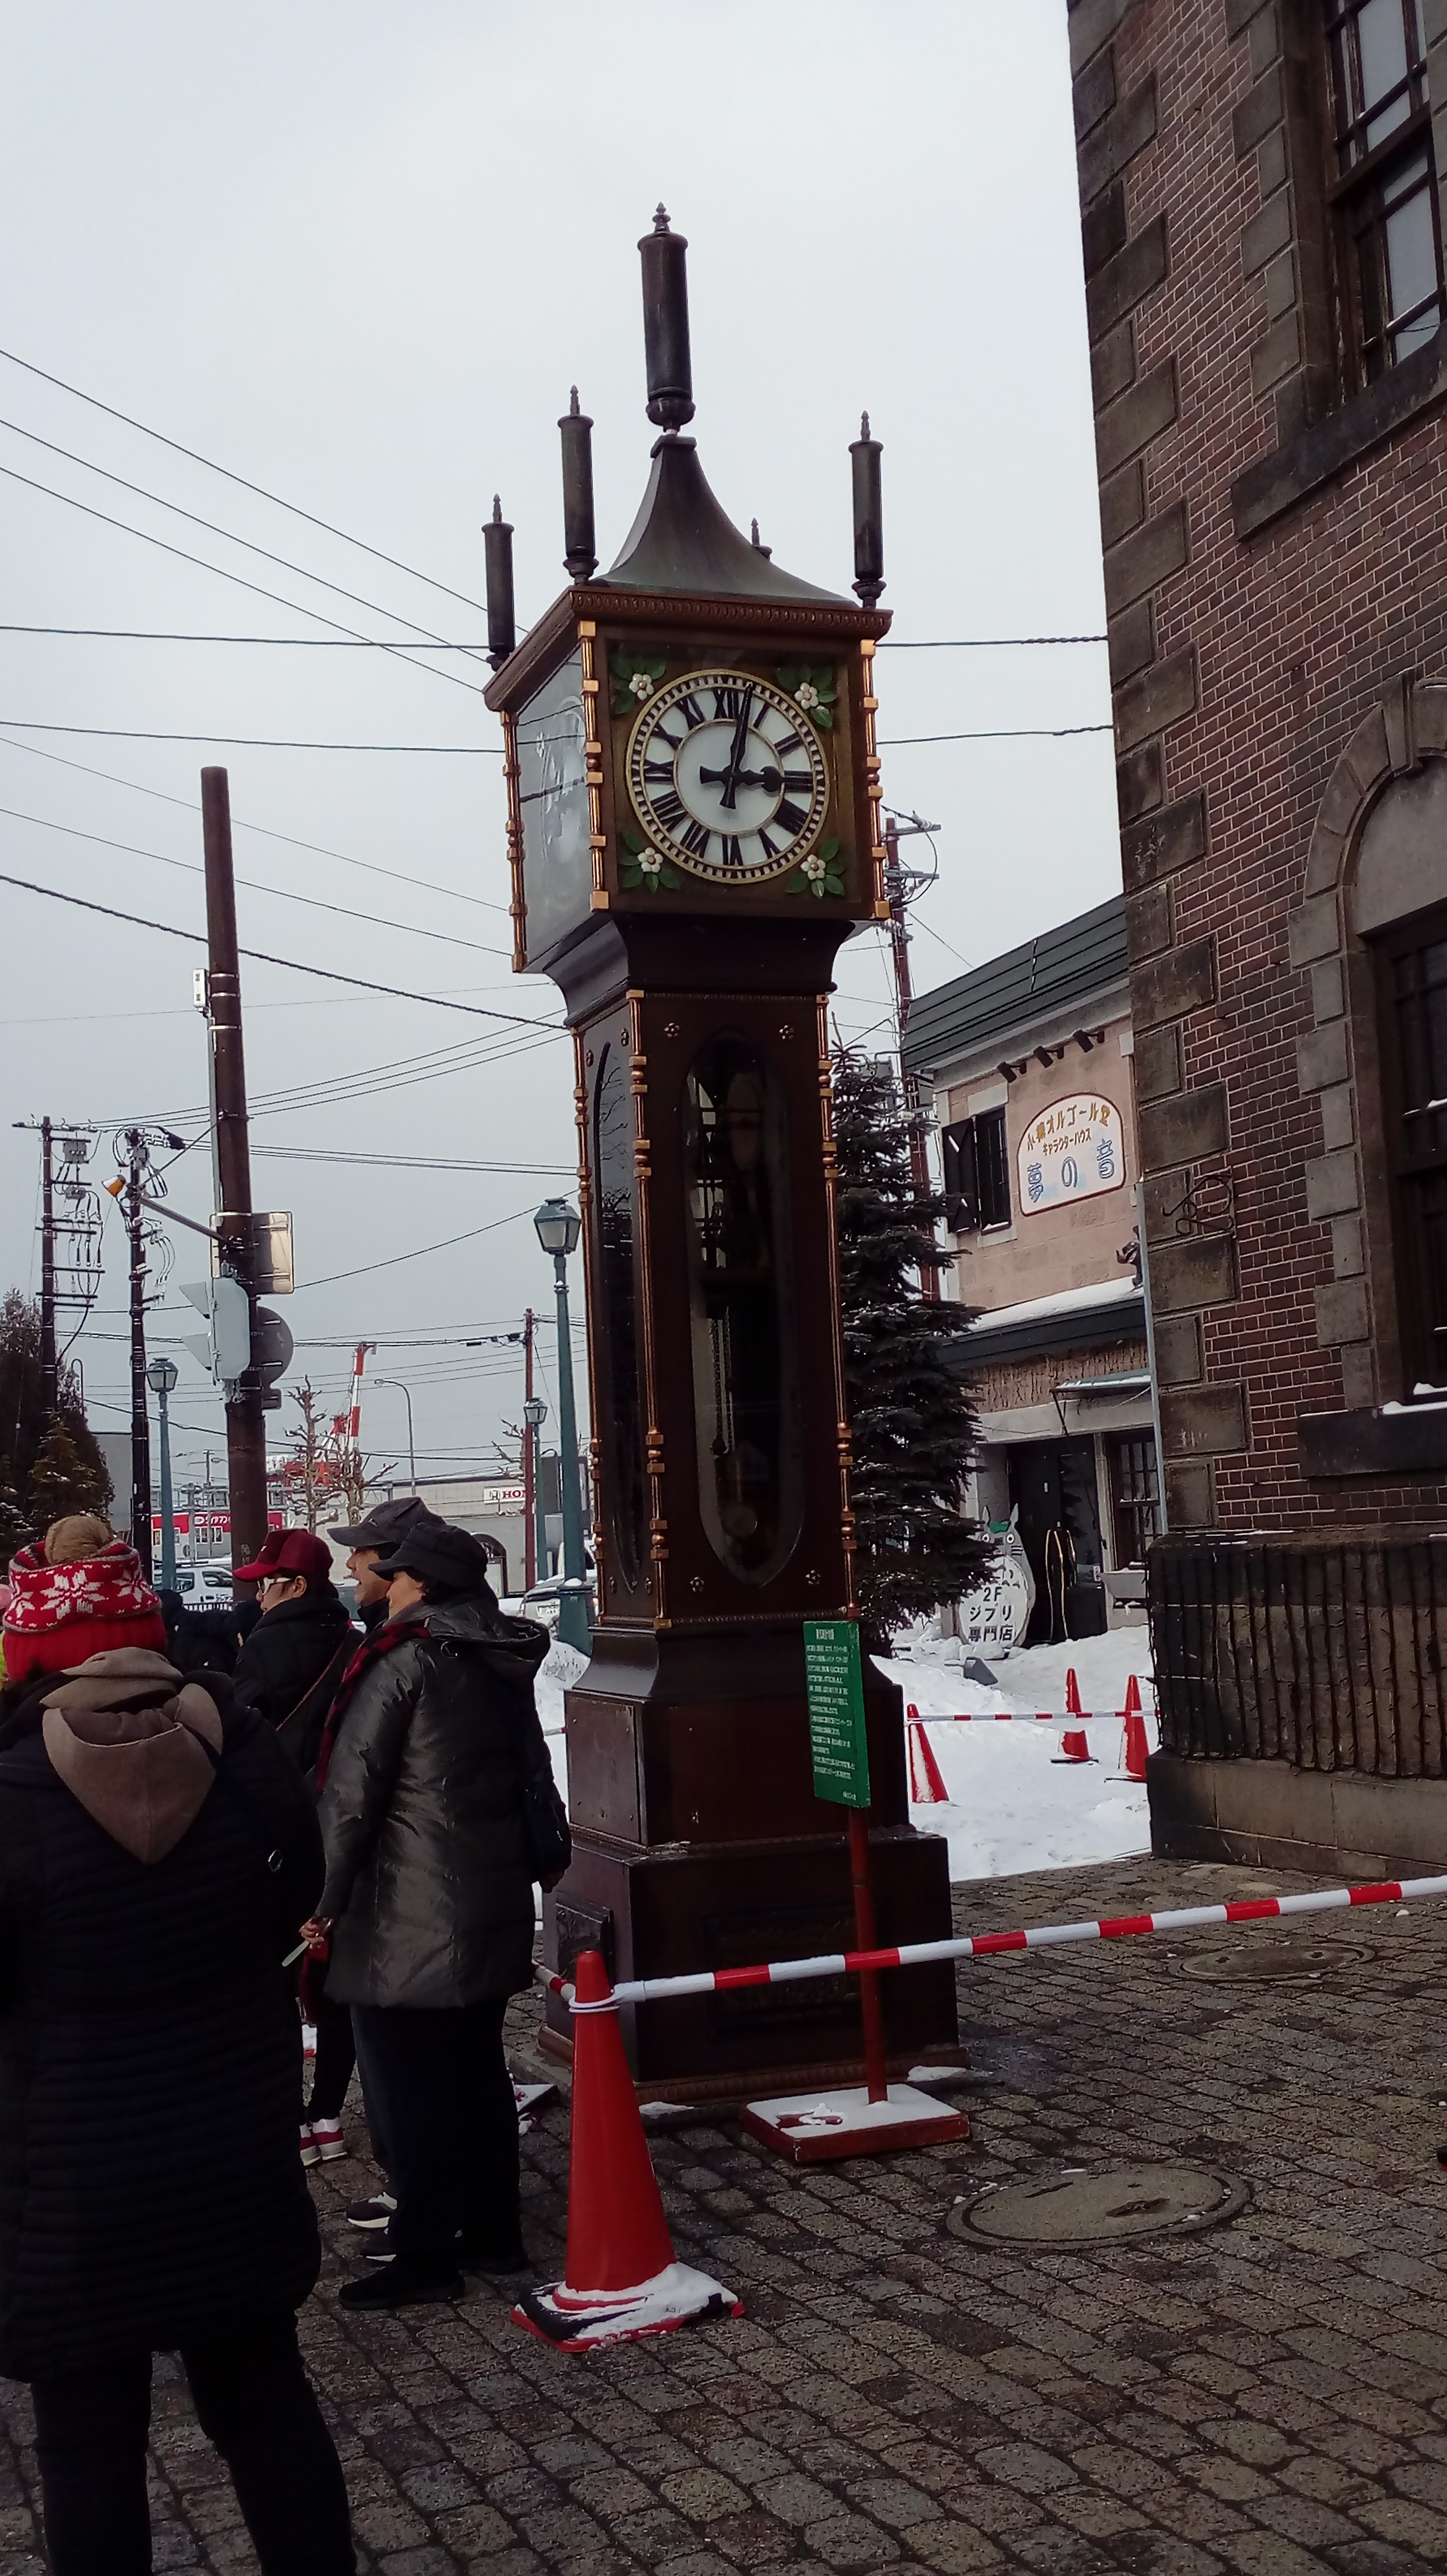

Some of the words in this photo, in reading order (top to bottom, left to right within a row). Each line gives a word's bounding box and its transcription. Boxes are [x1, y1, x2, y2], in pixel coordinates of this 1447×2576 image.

[713, 689, 740, 720] XII
[983, 1586, 1002, 1602] 2F
[969, 1603, 1012, 1622] ジブリ
[968, 1624, 1013, 1642] 専門店
